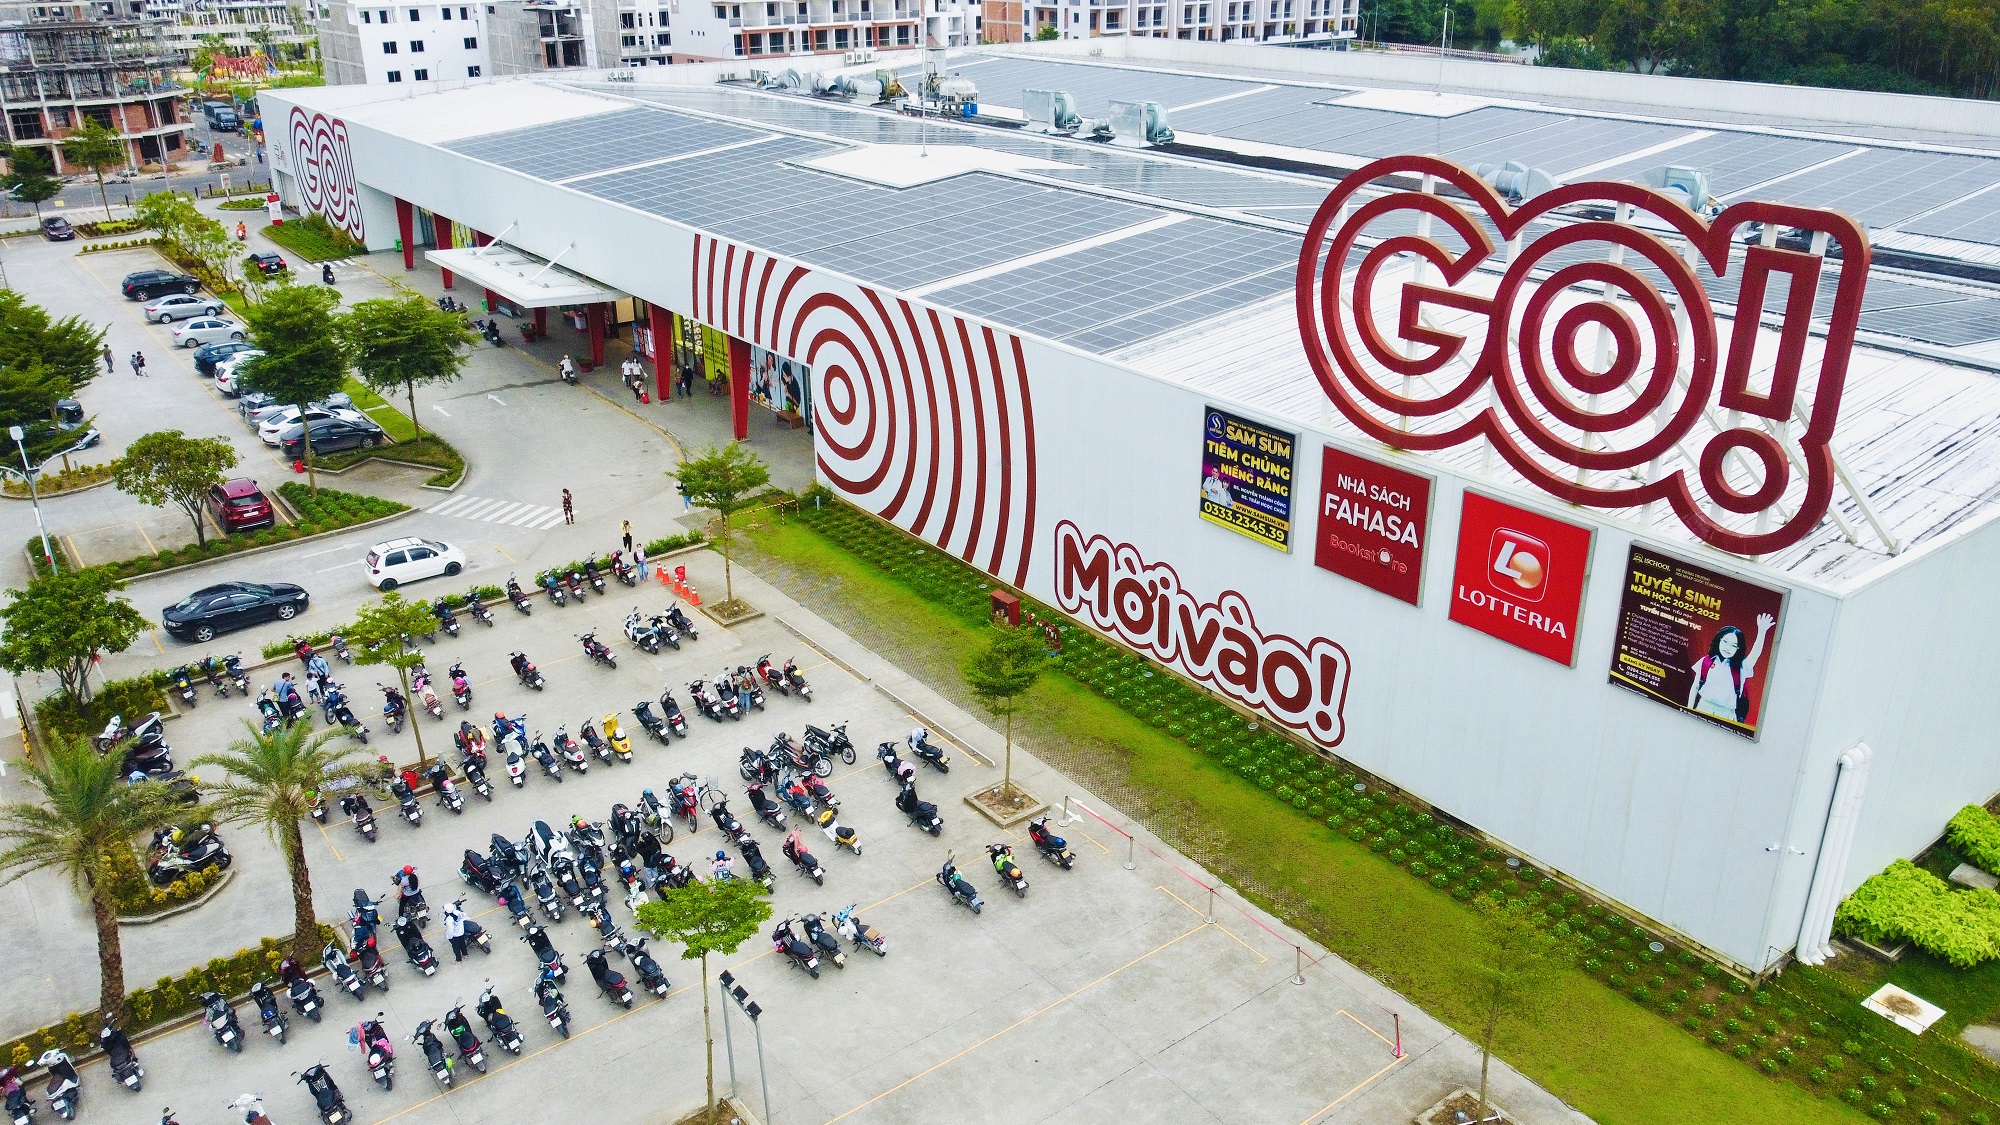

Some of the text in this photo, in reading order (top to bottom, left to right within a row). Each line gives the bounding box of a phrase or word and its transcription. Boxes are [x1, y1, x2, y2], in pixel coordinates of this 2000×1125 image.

[289, 106, 365, 244] GO!
[1296, 155, 1871, 556] GO!
[1207, 440, 1290, 480] TIÊM CHỦNG
[1226, 426, 1290, 459] SAM SUM
[1221, 463, 1288, 497] NIỀNG RĂNG
[1338, 474, 1410, 511] NHÀ SÁCH
[1204, 500, 1284, 542] 0333.2345.39
[1325, 493, 1418, 548] FAHASA
[1631, 584, 1721, 620] NĂM HỌC 2022-2023
[1633, 571, 1721, 610] TUYỂN SINH
[1459, 584, 1567, 639] LOTTERIA
[1059, 528, 1343, 738] Mời vào!
